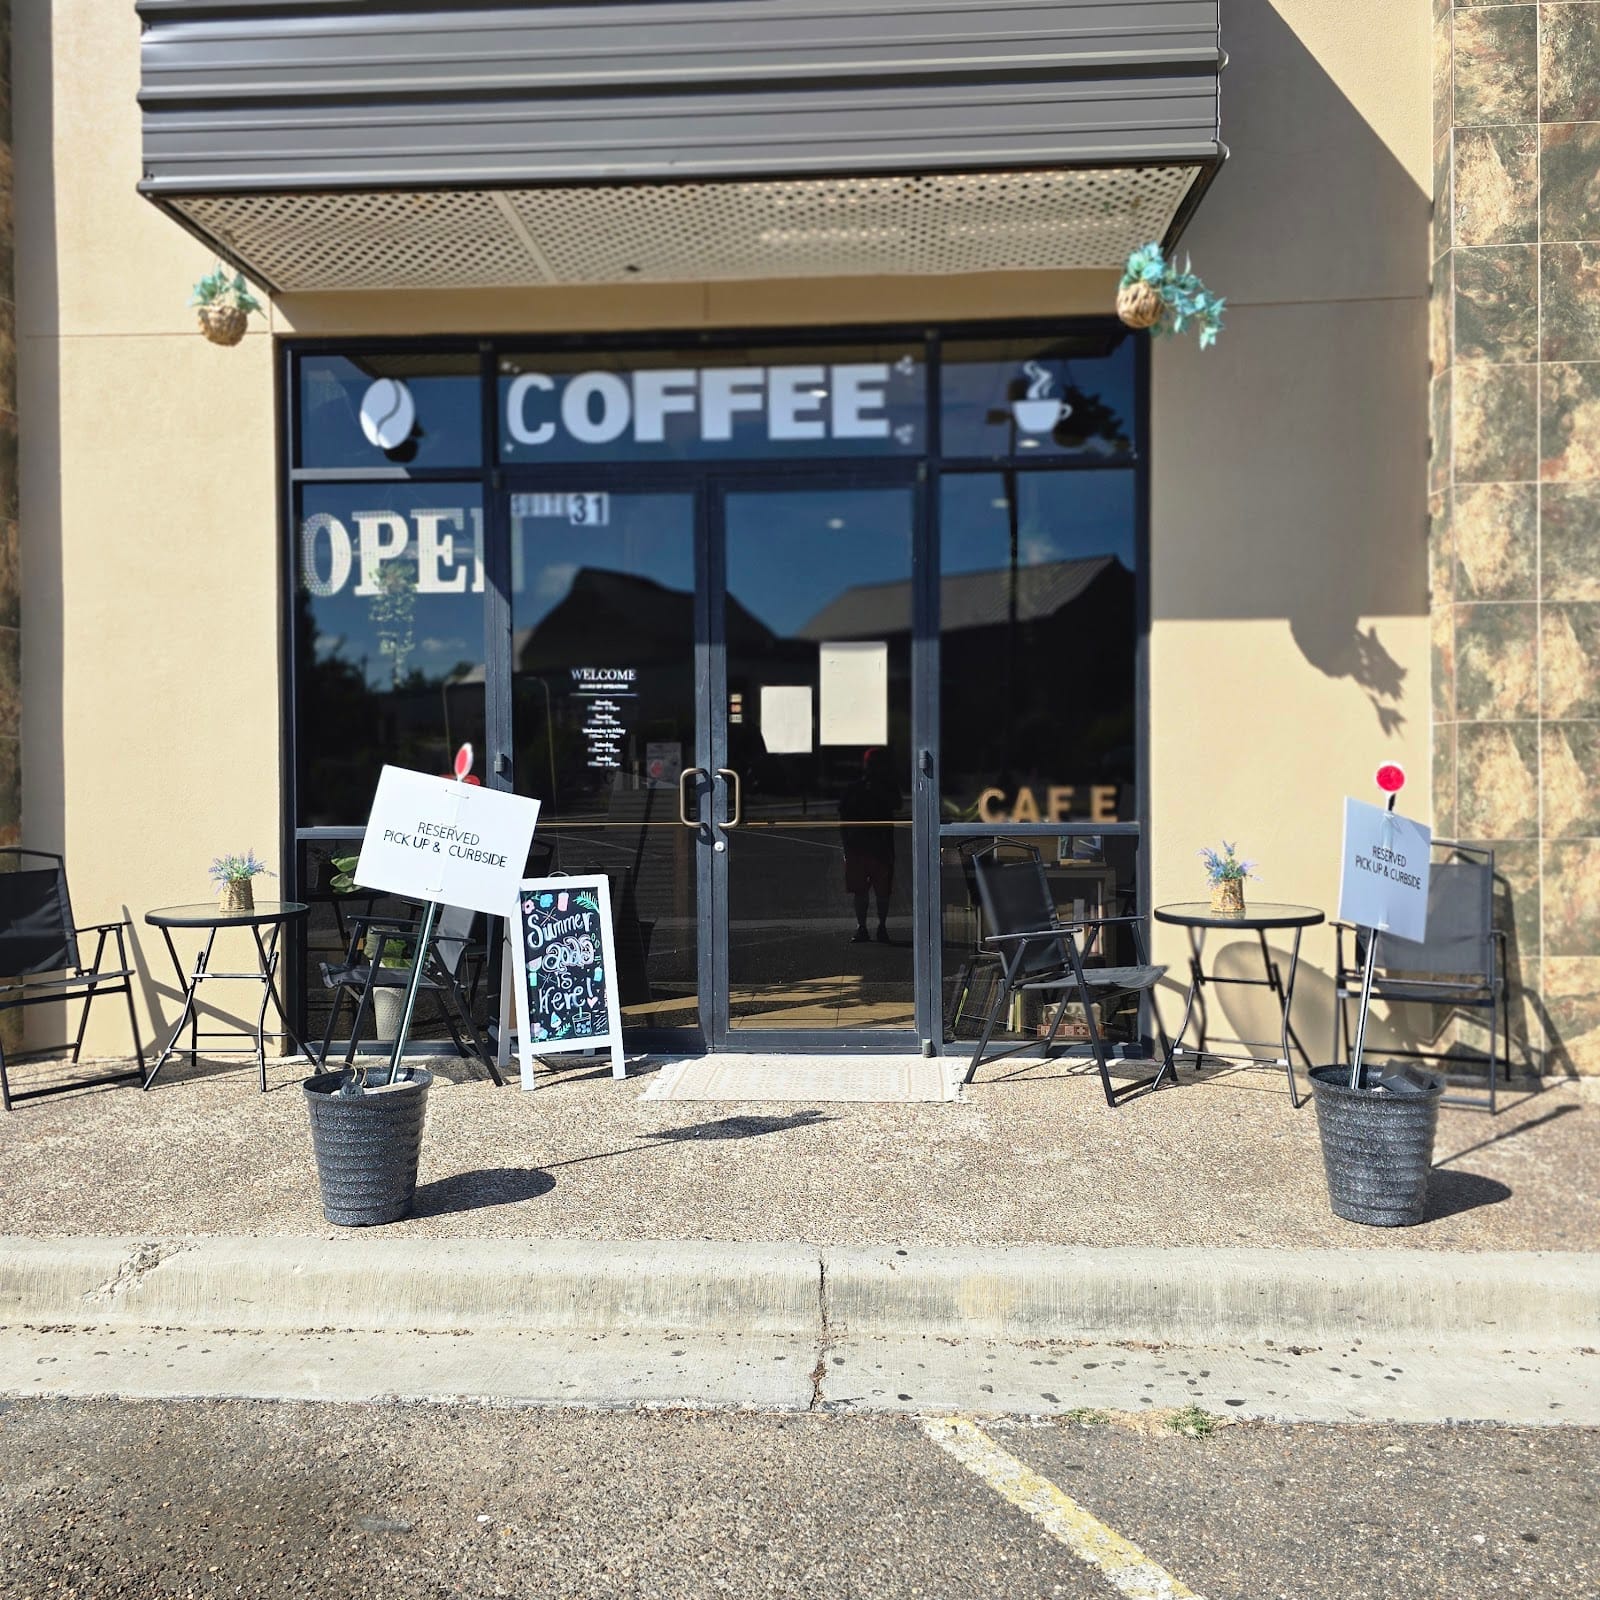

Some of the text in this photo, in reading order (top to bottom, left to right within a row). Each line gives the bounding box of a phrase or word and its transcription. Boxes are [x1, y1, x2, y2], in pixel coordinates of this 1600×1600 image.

[506, 363, 890, 444] COFFEE
[574, 494, 603, 523] 31
[571, 668, 636, 681] WELCOME
[384, 829, 508, 868] PICK UP & CURBSIDE
[417, 821, 480, 846] RESERVED
[1355, 855, 1421, 890] PICK UP & CURBSIDE
[1372, 846, 1407, 867] RESERVED
[527, 912, 594, 948] Summer
